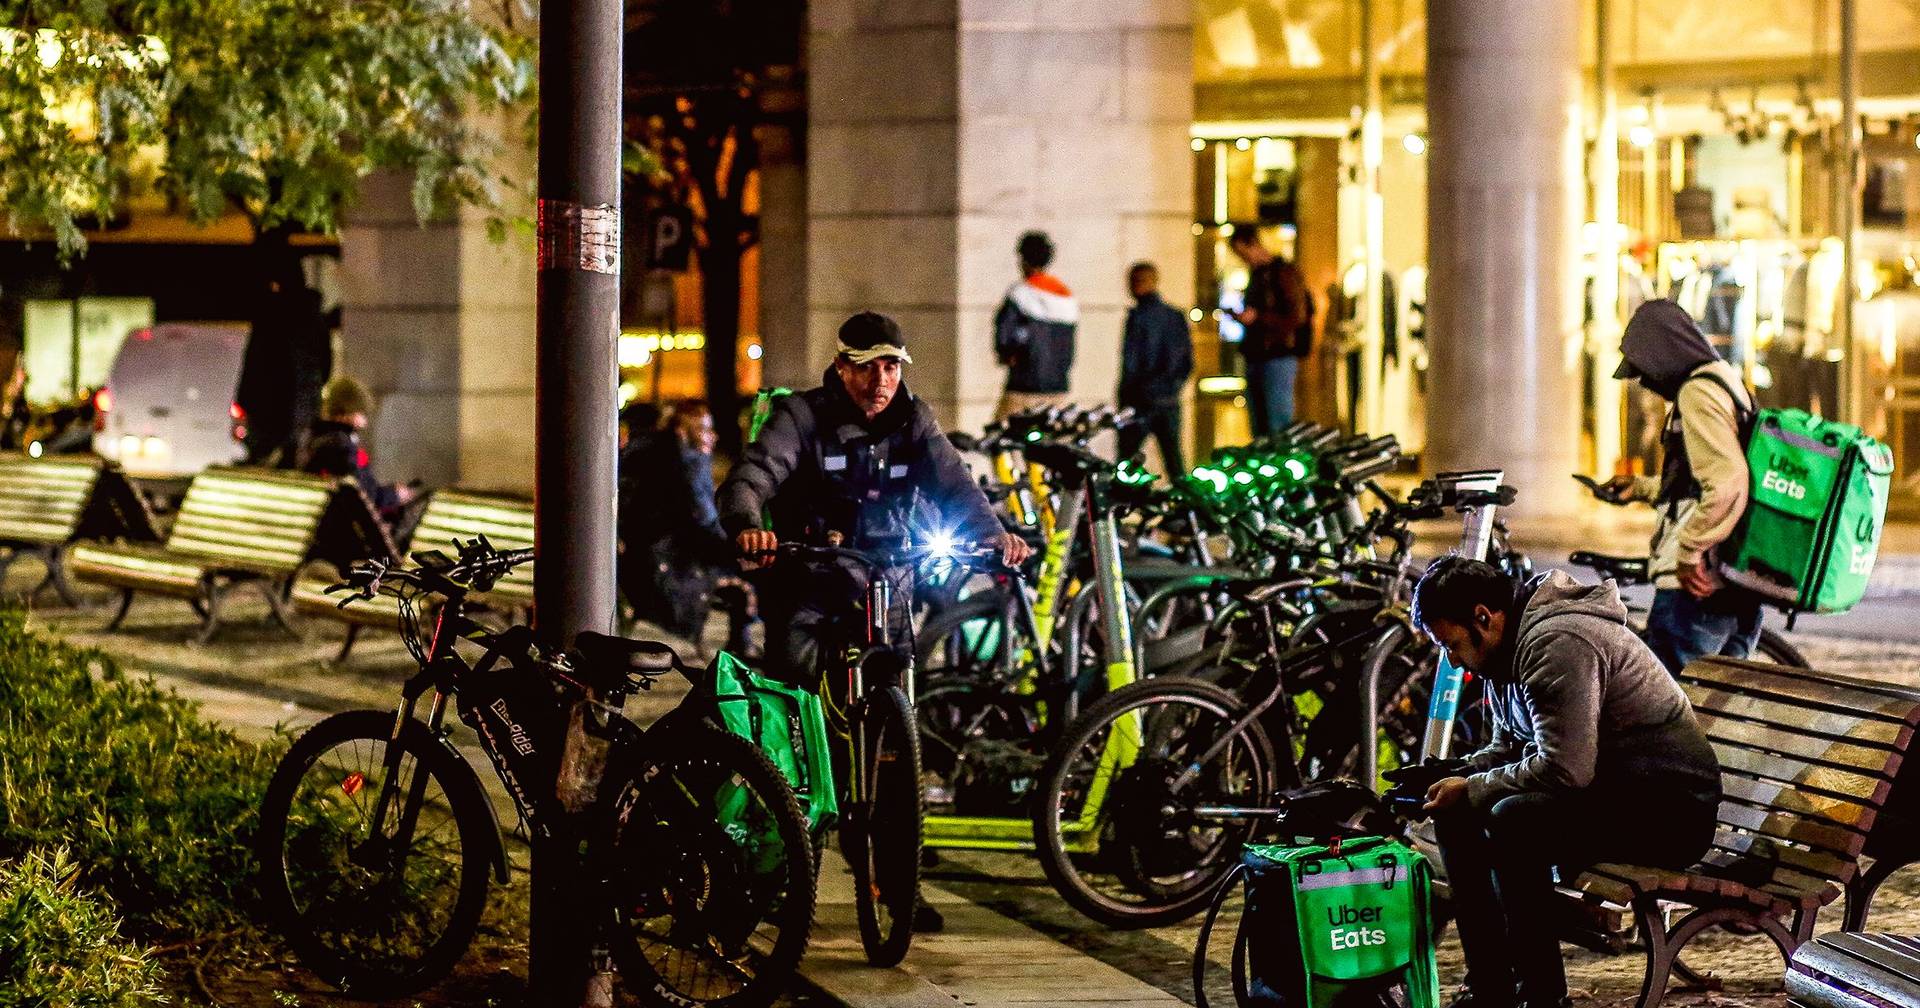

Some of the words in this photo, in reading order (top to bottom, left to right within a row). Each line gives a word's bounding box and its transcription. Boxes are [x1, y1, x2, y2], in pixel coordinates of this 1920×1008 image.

[655, 215, 682, 261] P
[1769, 453, 1809, 477] Uber
[1762, 471, 1806, 499] Eats
[1328, 904, 1383, 925] Uber
[1331, 927, 1385, 950] Eats
